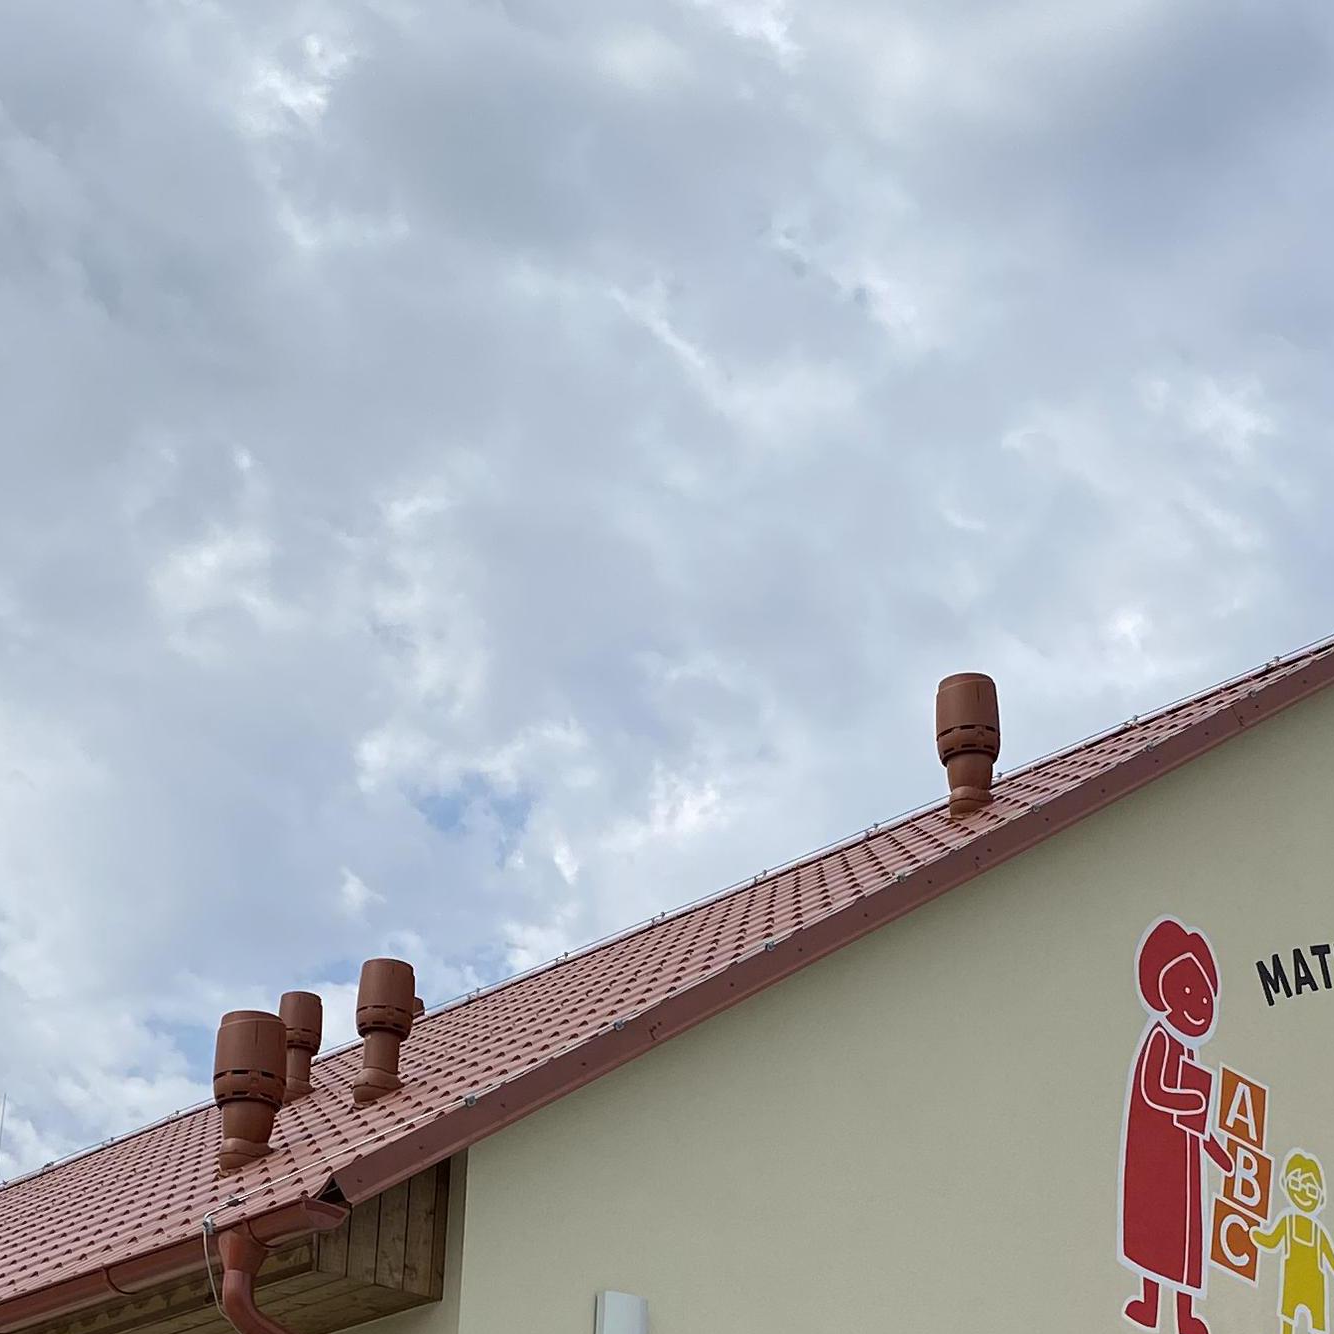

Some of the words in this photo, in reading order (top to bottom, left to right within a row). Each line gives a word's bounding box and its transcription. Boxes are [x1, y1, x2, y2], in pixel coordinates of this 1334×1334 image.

[1225, 1082, 1258, 1141] A
[1233, 1146, 1261, 1207] B
[1220, 1214, 1250, 1267] C
